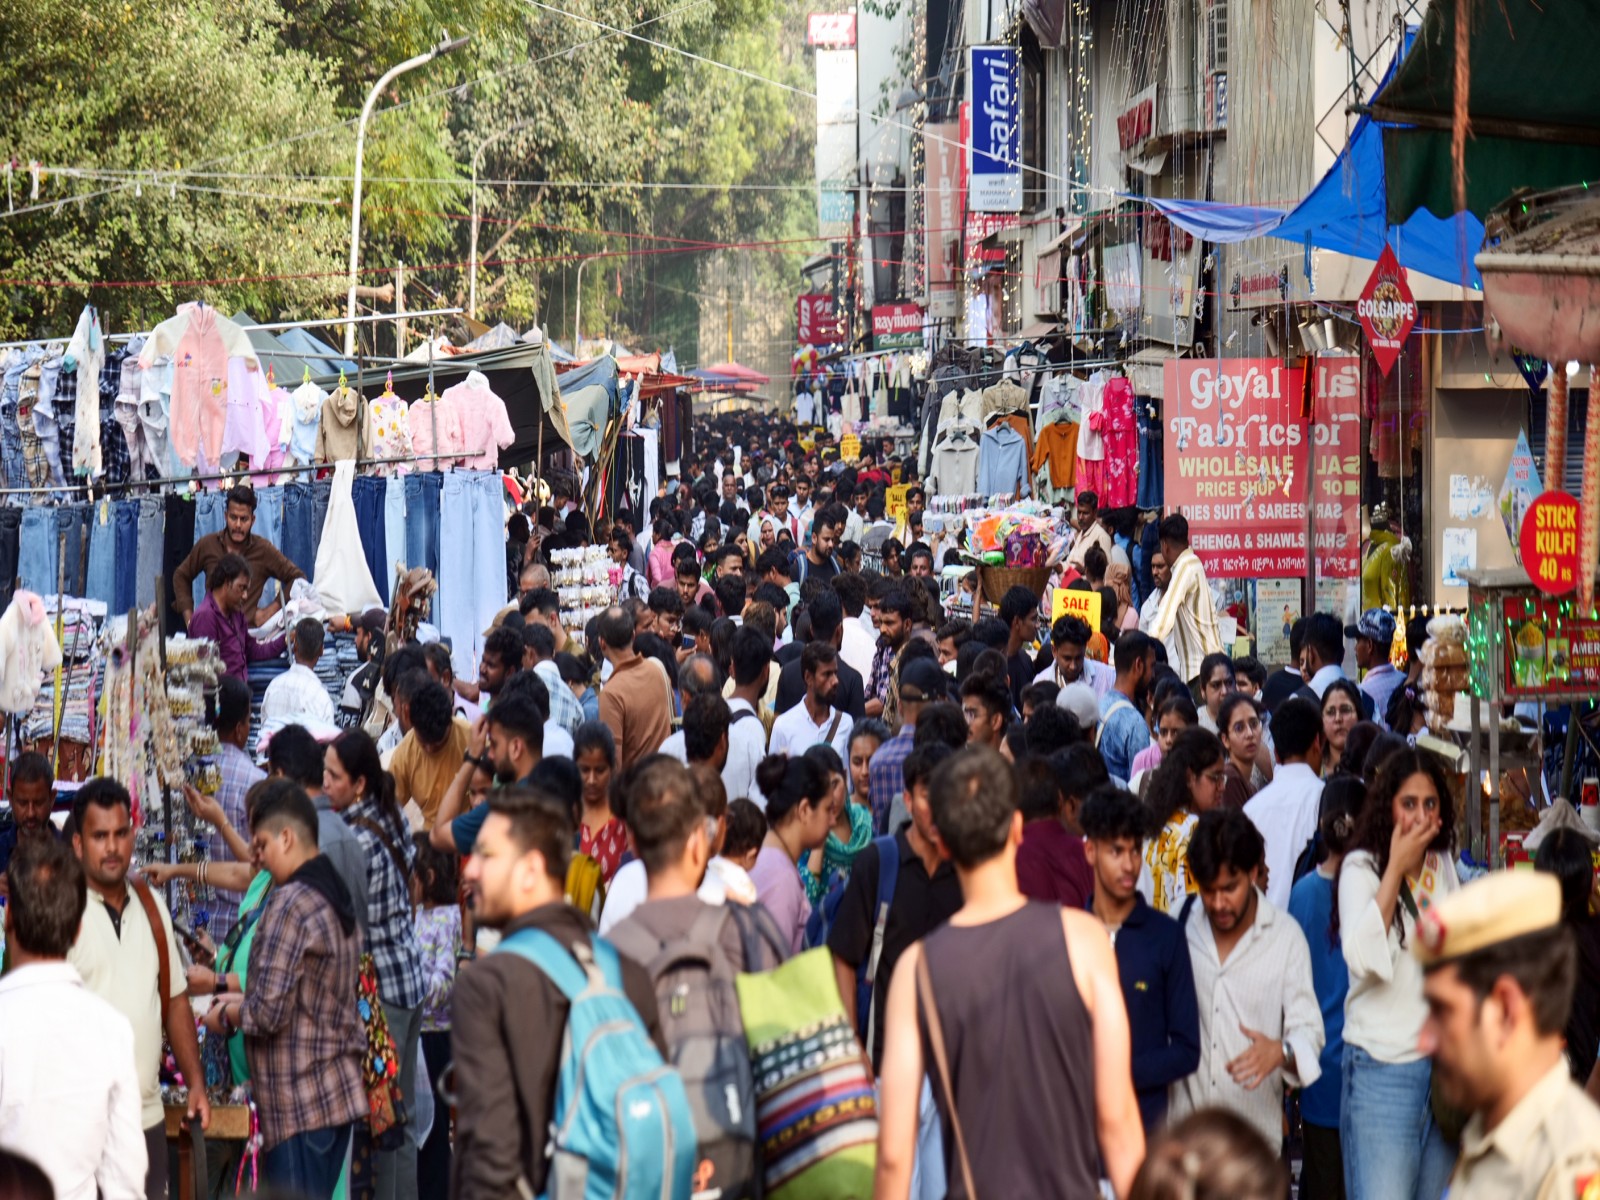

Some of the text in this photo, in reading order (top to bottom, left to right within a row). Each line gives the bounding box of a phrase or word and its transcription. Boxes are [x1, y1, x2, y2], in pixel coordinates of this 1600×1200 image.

[983, 57, 1009, 162] safari
[983, 199, 1009, 207] LUGGAGE
[1358, 298, 1414, 320] GOLGAPPE
[874, 311, 922, 333] Raymond
[1189, 366, 1281, 409] Goyal
[1170, 413, 1302, 449] Fabrics
[1178, 455, 1294, 477] WHOLESALE
[1196, 480, 1276, 497] PRICE SHOP
[1167, 503, 1306, 521] LDIES SUIT & SAREES
[1535, 504, 1577, 529] STICK
[1190, 533, 1305, 550] EHENGA & SHAWLS
[1535, 531, 1576, 555] KULFI
[1539, 557, 1572, 582] 40 RS
[1062, 596, 1090, 612] SALE
